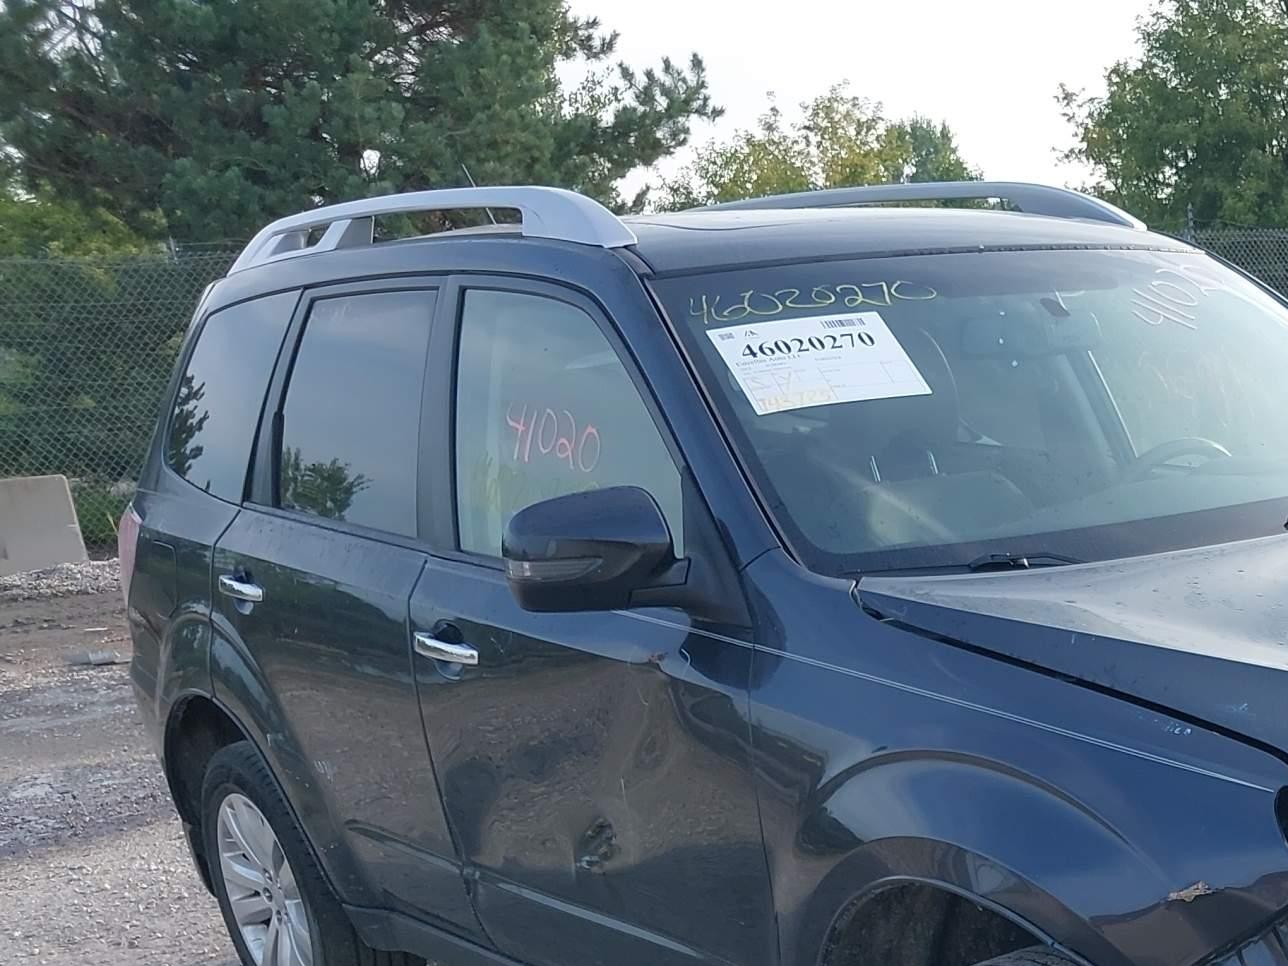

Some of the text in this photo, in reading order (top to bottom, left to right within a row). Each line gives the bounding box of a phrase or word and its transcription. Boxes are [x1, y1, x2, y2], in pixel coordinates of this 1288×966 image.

[690, 281, 937, 324] 46020270
[741, 331, 876, 359] 46020270
[506, 402, 600, 473] 41020
